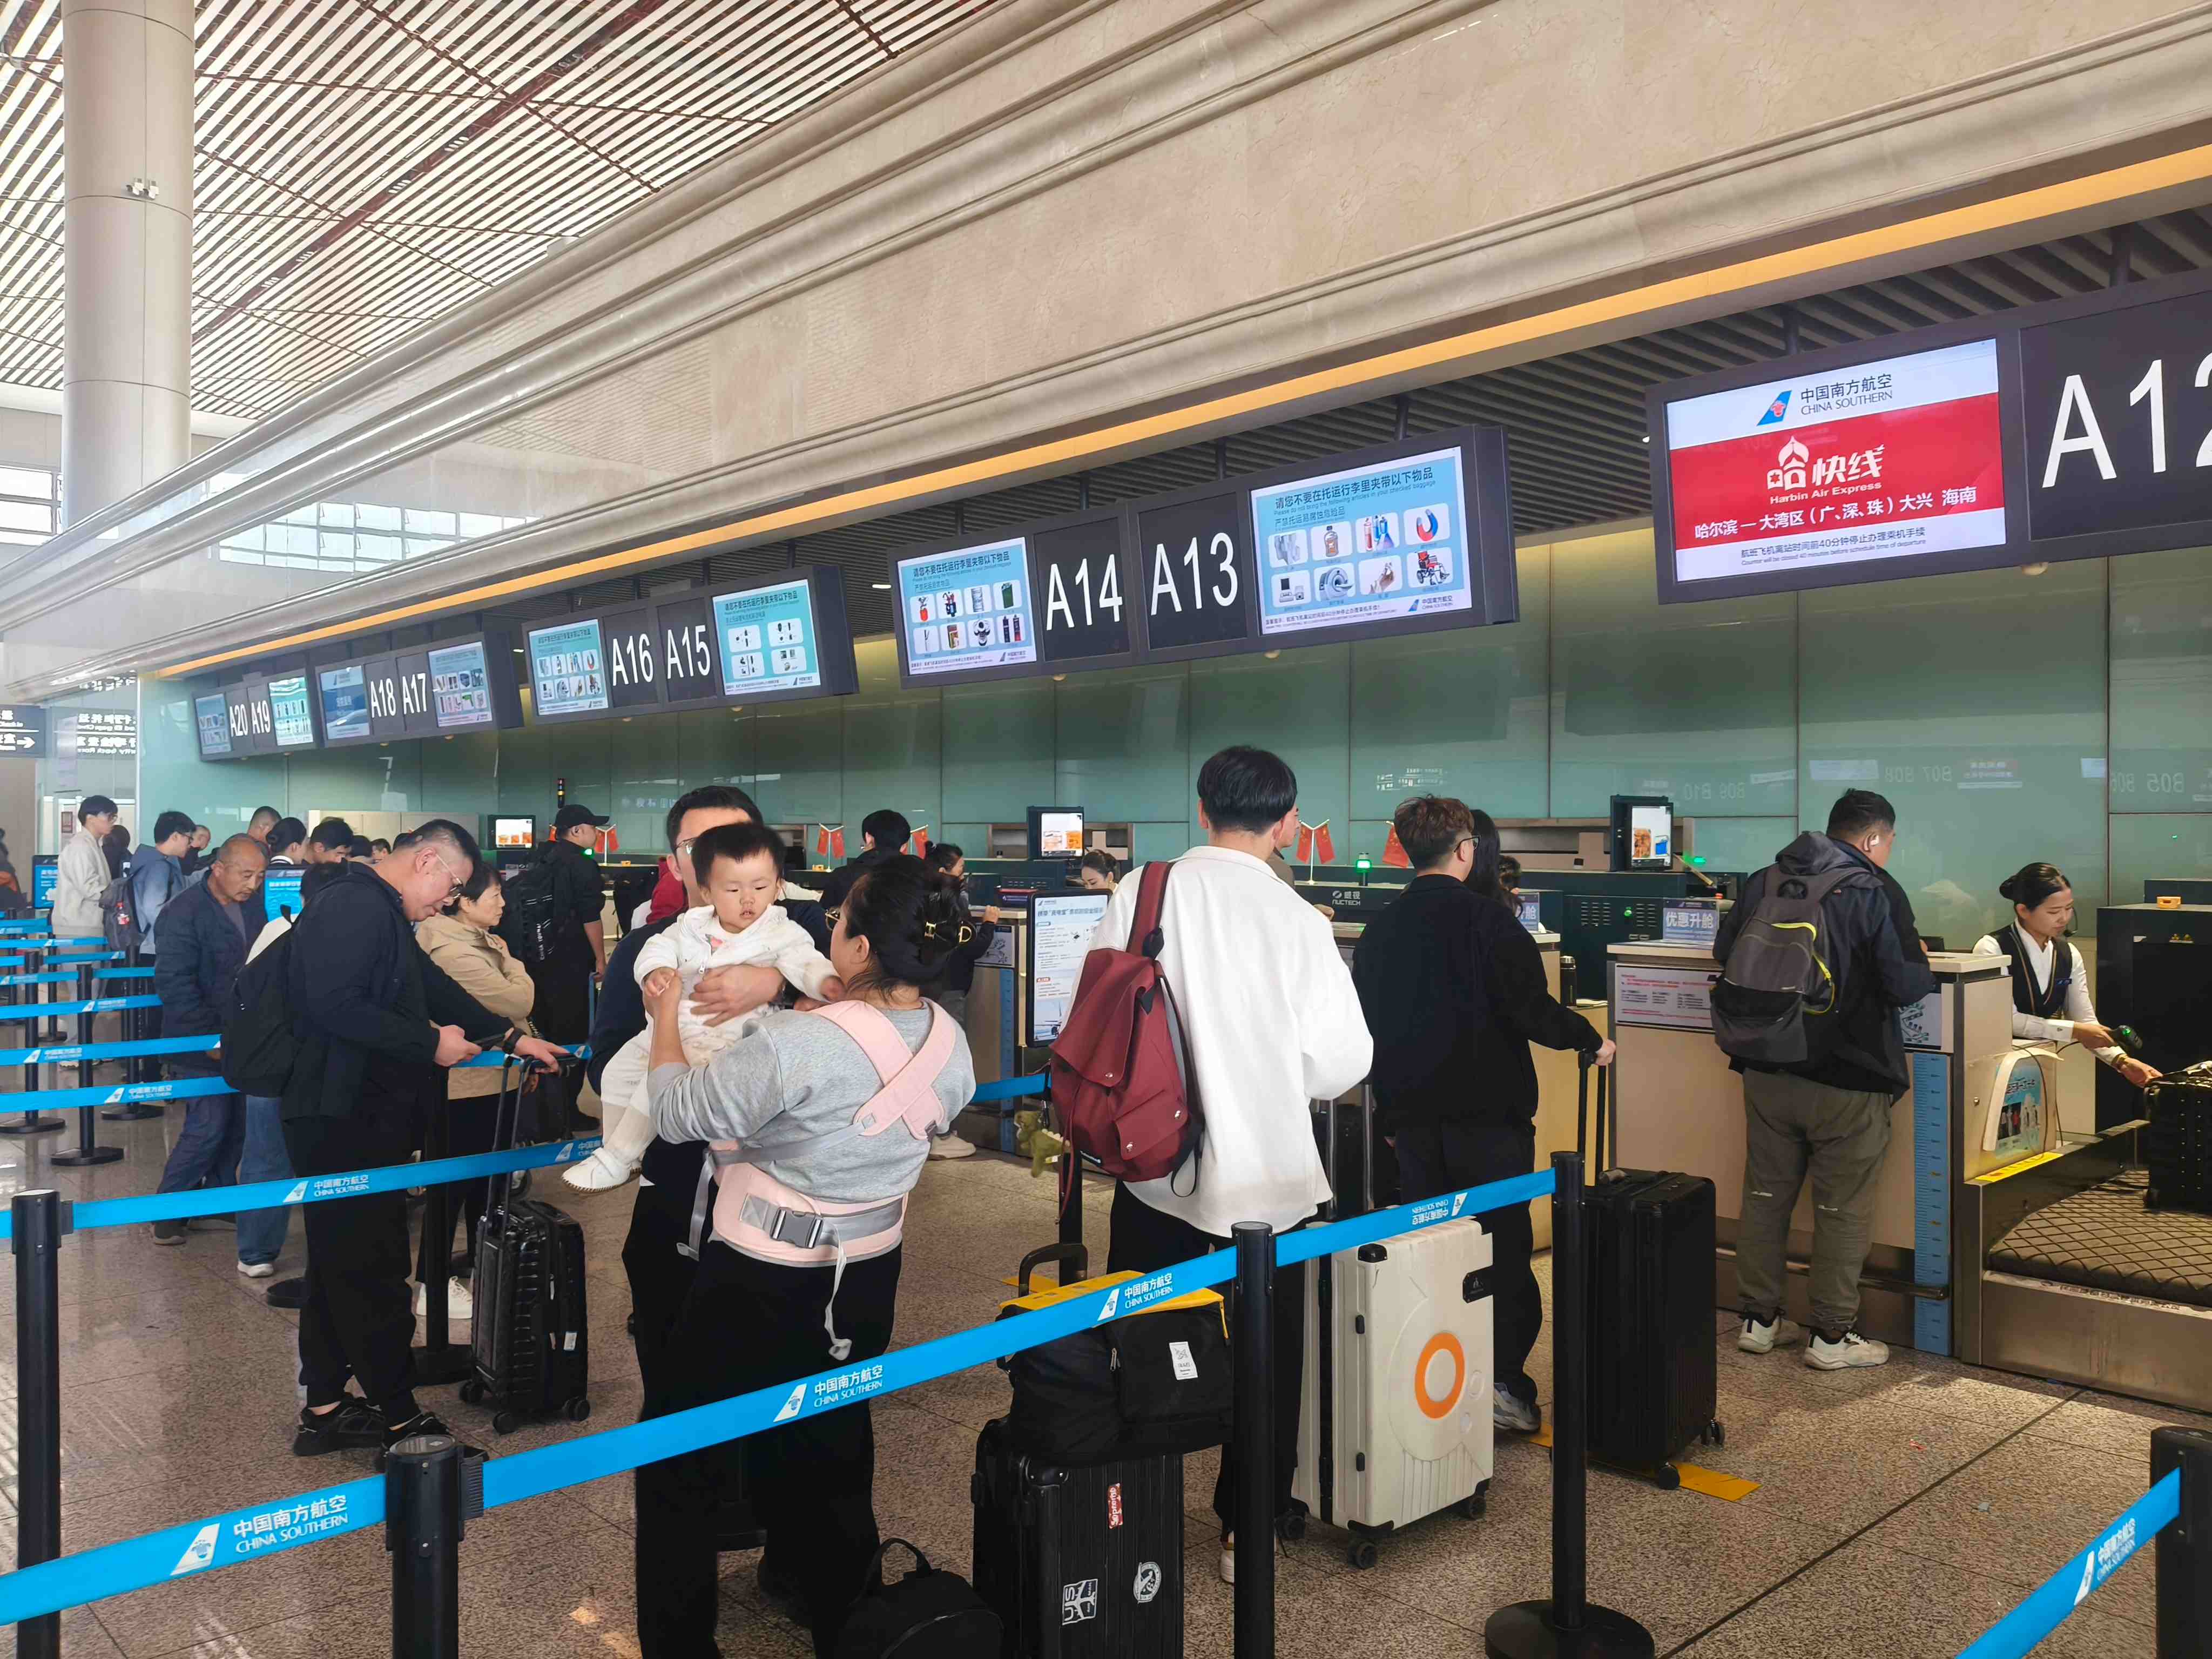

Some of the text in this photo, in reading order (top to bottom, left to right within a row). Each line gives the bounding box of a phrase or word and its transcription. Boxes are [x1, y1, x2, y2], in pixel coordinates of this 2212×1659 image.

[1800, 374, 1892, 404] 中国南方航空
[1801, 389, 1892, 416] CHINA SOUTHERN
[1276, 467, 1433, 509] 请您不要在托运行李里夹带以下物品
[1770, 480, 1882, 504] Harbin Air Express
[1150, 532, 1238, 616] A13
[1046, 554, 1123, 631] A14
[612, 633, 654, 686] A16
[666, 624, 711, 679] A15
[370, 678, 396, 718] A18
[402, 673, 427, 714] A17
[229, 704, 248, 737] A20
[251, 700, 271, 734] A19
[1665, 911, 1714, 929] 优惠升舱
[314, 1174, 369, 1189] 中国南方航空
[314, 1183, 369, 1197] CHINA SOUTHERN
[1124, 1272, 1173, 1298] 中国南方航空
[1124, 1286, 1173, 1309] CHINA SOUTHERN
[814, 1364, 884, 1396] 中国南方航空
[814, 1380, 882, 1407] CHINA SOUTHERN
[234, 1495, 347, 1537] 中国南方航空
[235, 1513, 348, 1554] CHINA SOUTHERN
